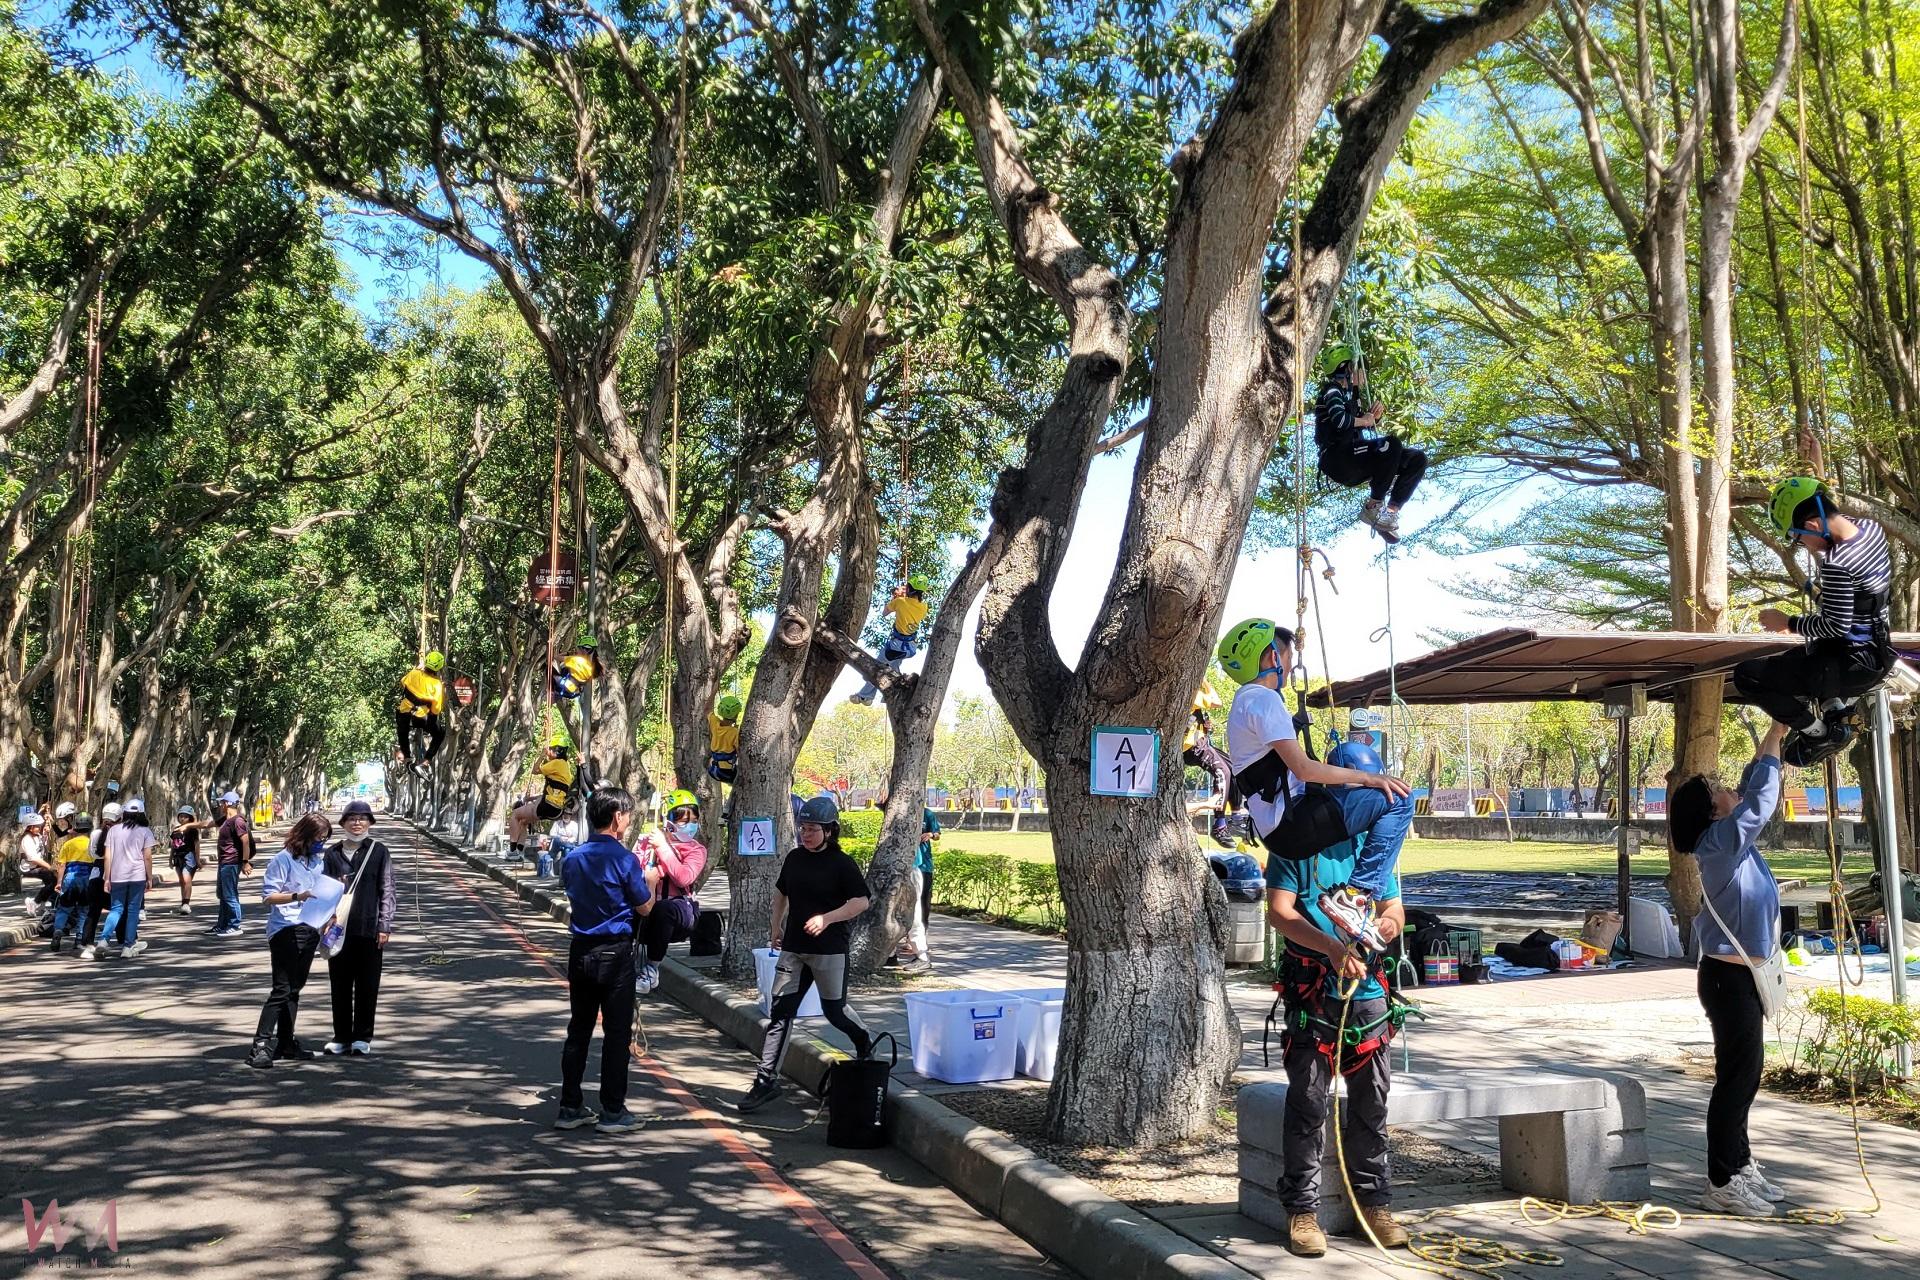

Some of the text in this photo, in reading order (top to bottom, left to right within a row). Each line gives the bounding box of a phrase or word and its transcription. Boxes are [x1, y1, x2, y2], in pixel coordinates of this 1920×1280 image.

[1115, 737, 1136, 761] A
[1112, 764, 1136, 790] 11
[750, 823, 762, 836] A
[749, 838, 766, 851] 12
